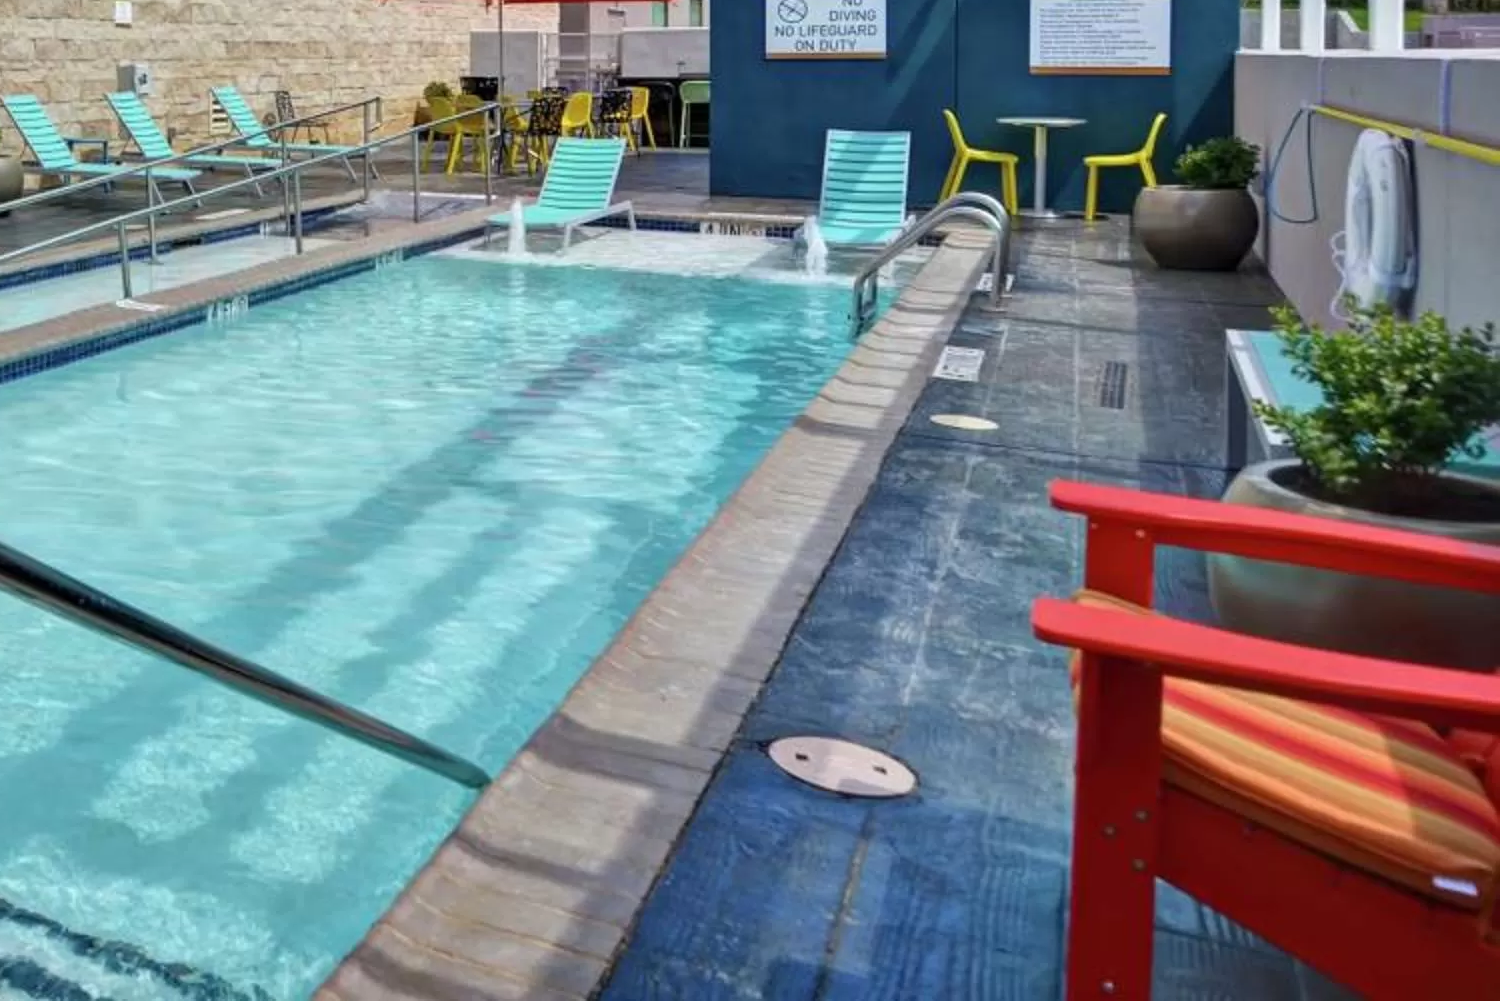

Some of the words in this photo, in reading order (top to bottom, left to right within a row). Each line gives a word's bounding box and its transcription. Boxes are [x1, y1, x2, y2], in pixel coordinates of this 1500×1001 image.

[829, 9, 877, 22] DIVING
[775, 25, 795, 37] NO
[799, 24, 878, 37] LIFEGUARD
[795, 39, 815, 51] ON
[820, 38, 857, 51] DUTY
